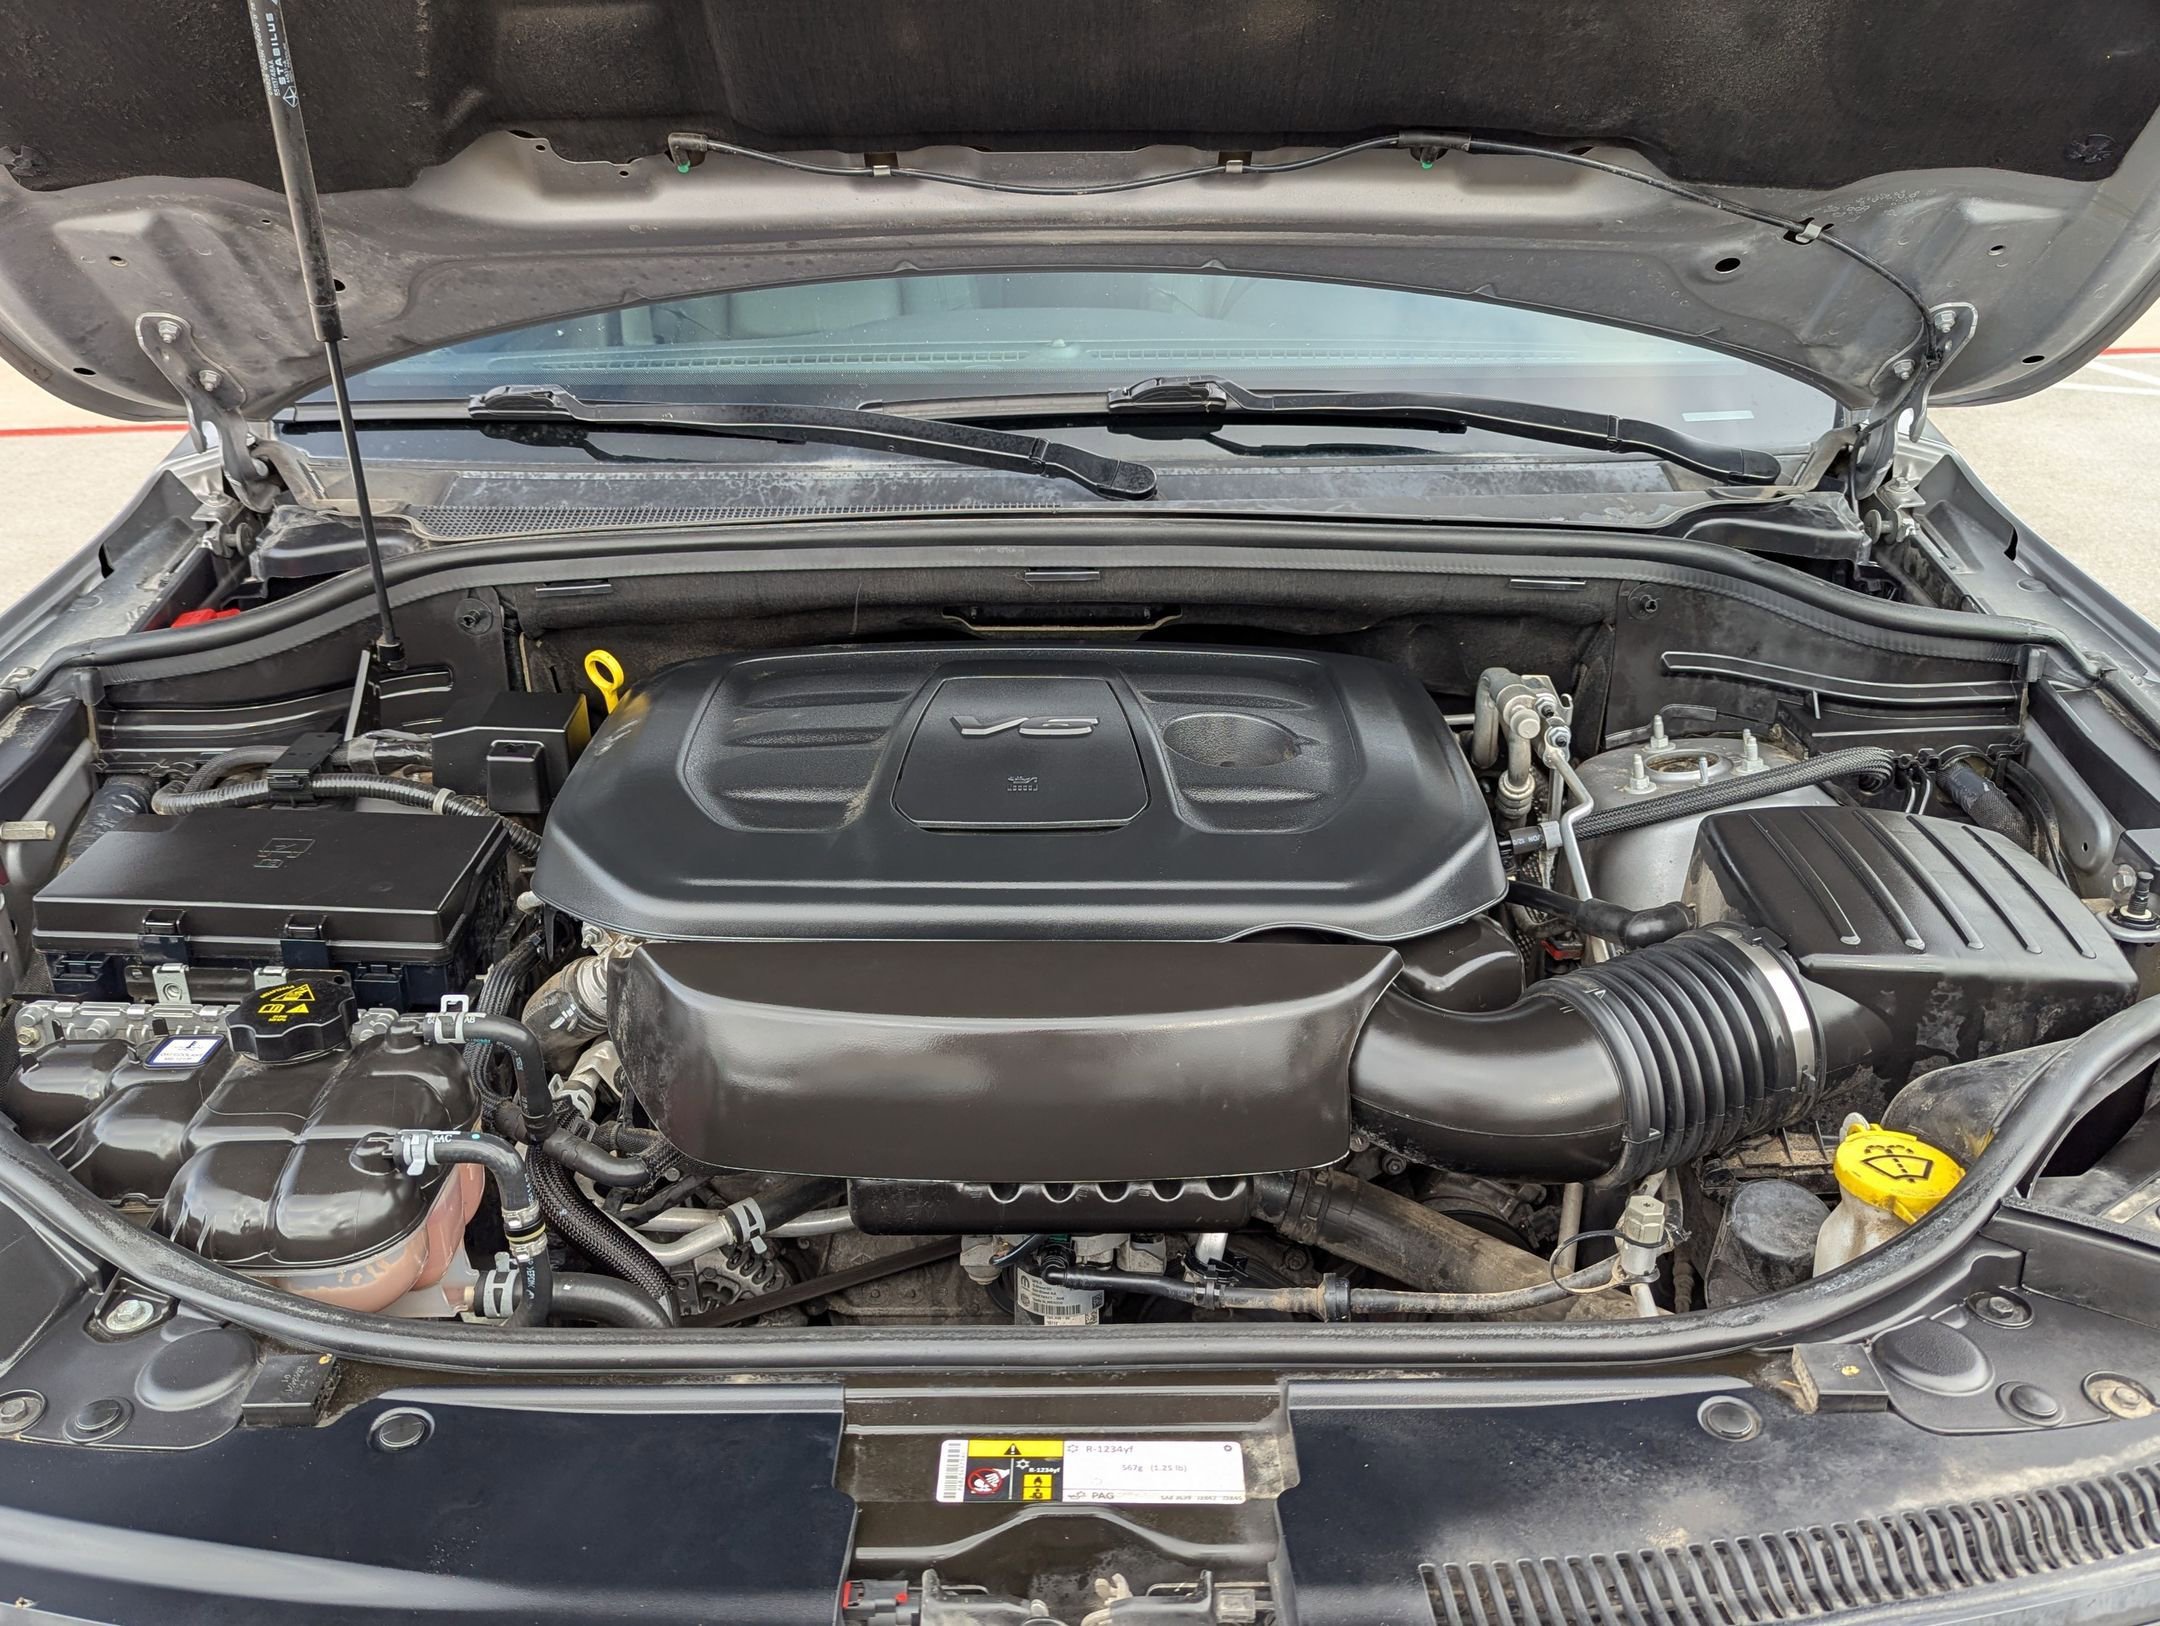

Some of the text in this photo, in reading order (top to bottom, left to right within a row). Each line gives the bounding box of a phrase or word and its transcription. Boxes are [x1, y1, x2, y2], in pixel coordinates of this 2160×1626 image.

[265, 13, 287, 85] STABILUS
[950, 715, 1099, 738] V6
[1086, 1445, 1134, 1454] R-1234yf
[1122, 1464, 1143, 1472] 567g
[1092, 1492, 1114, 1500] PAG
